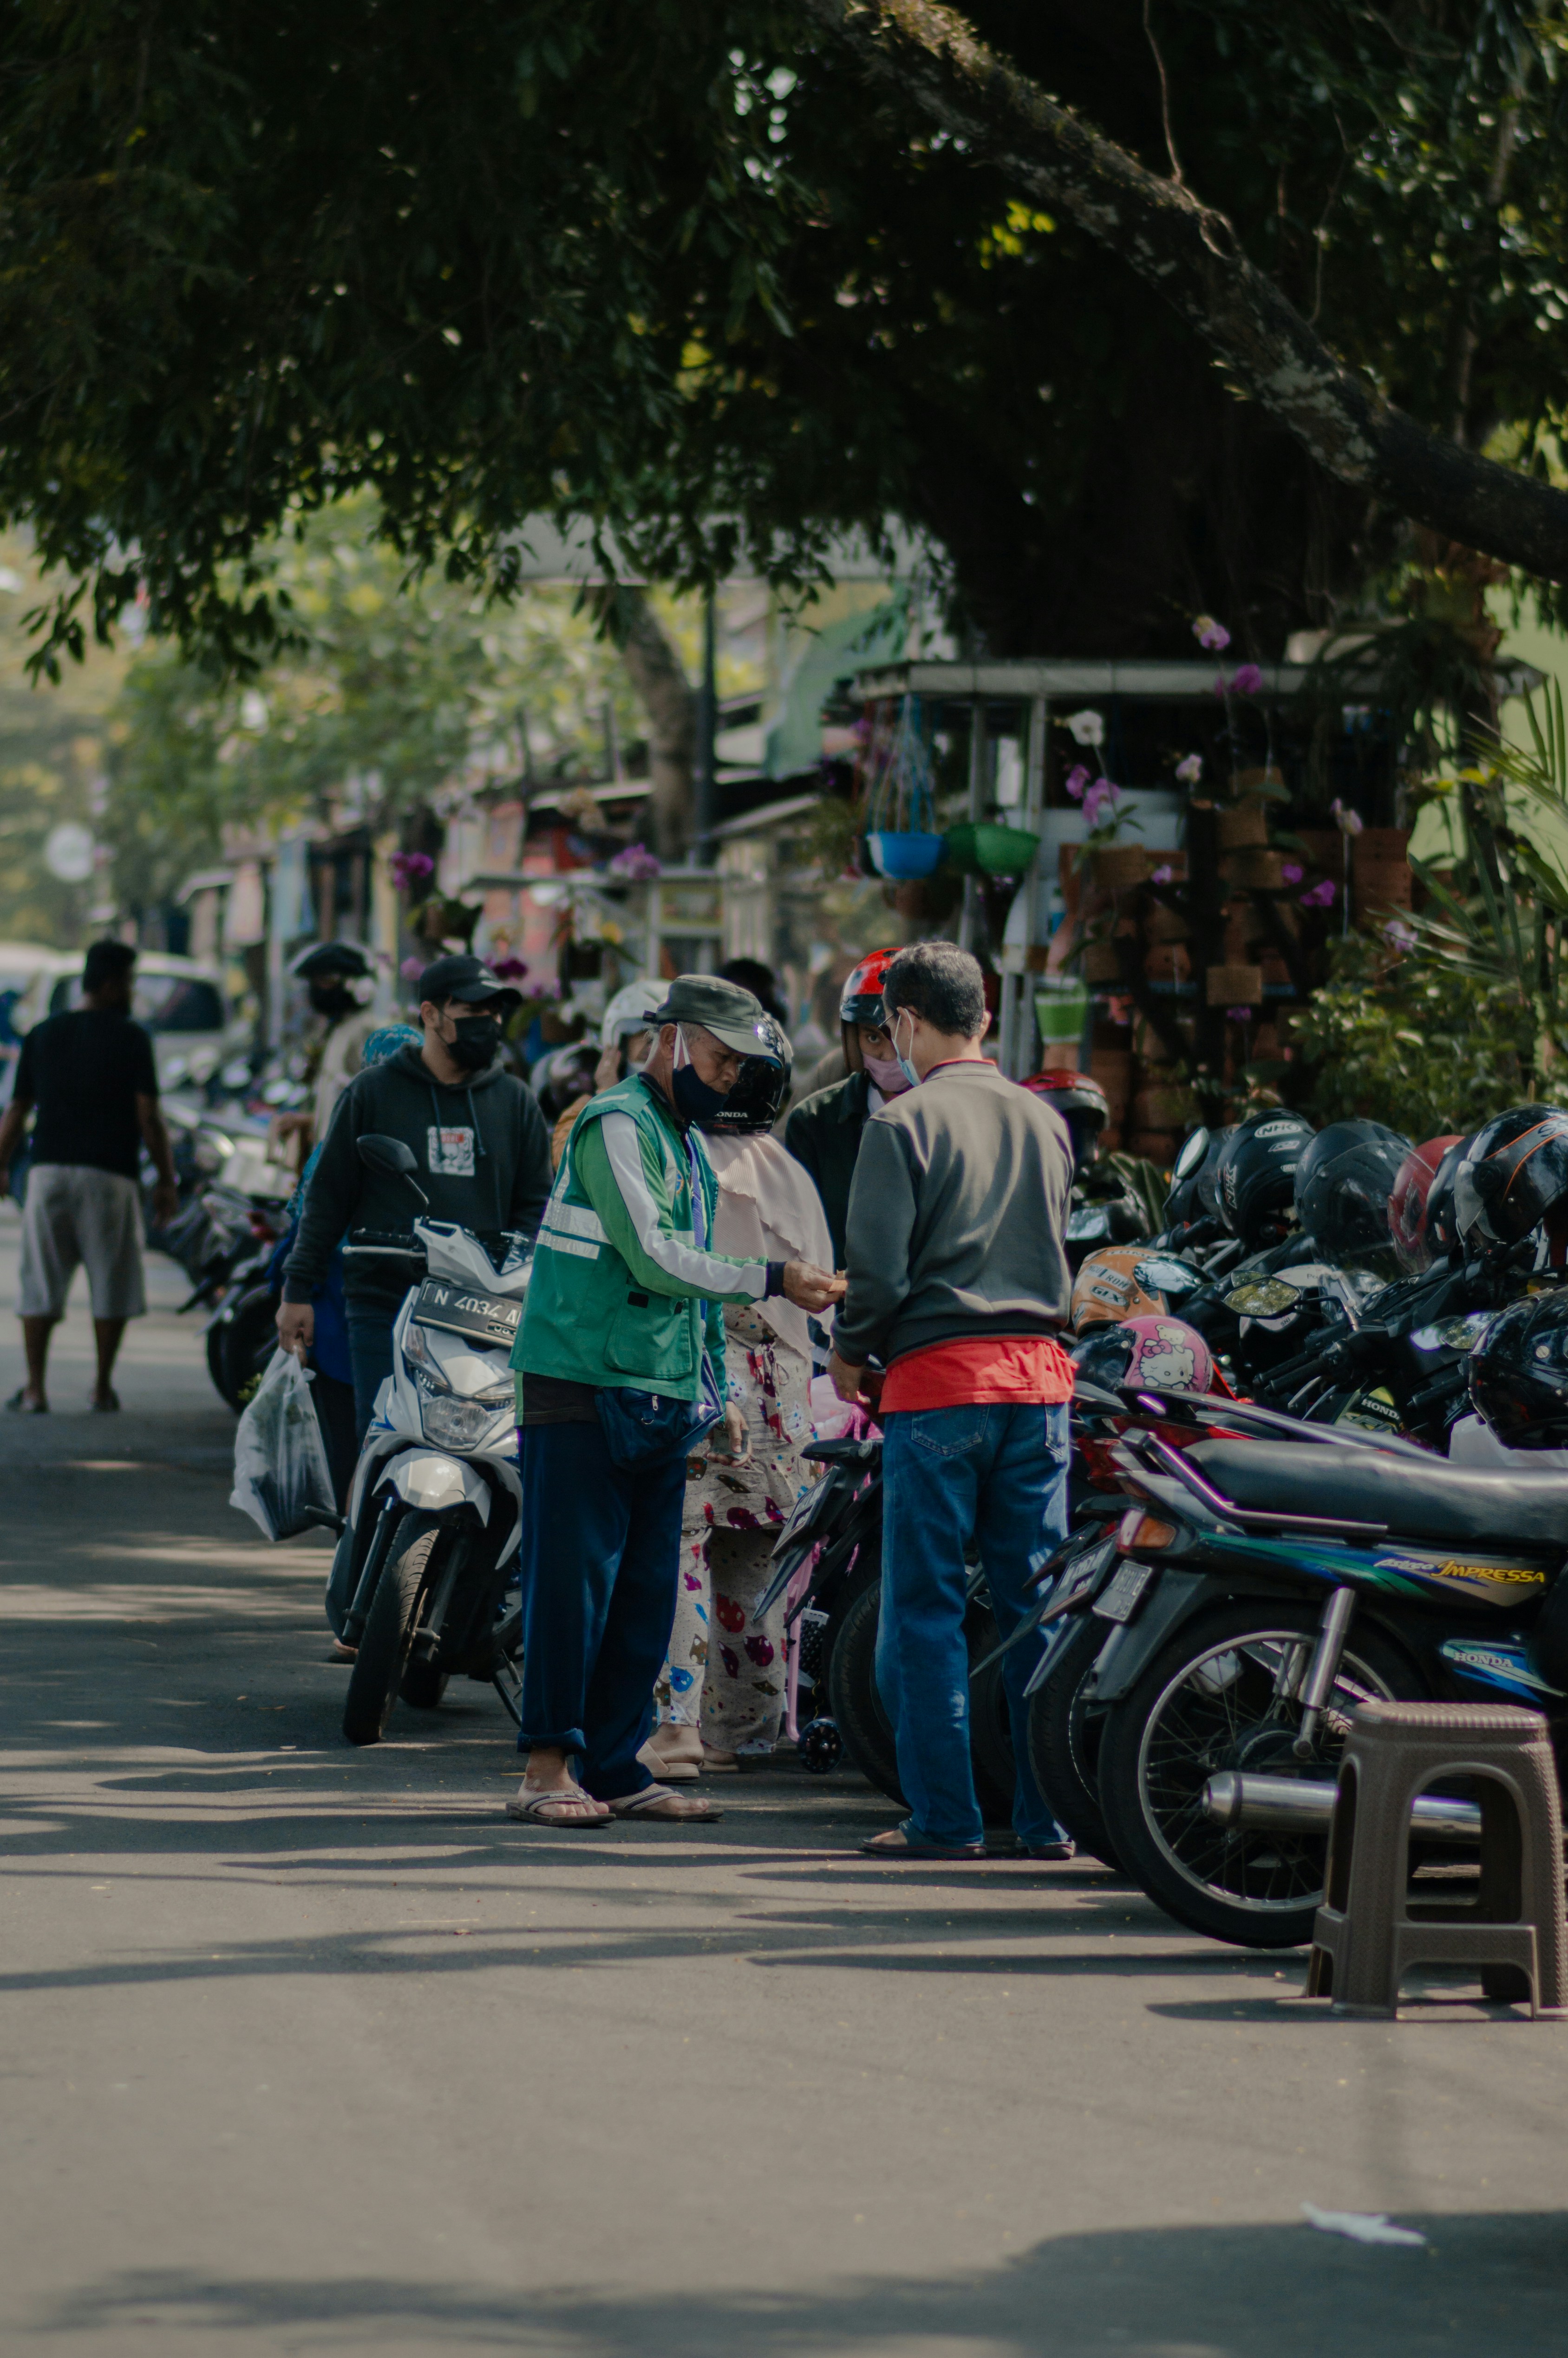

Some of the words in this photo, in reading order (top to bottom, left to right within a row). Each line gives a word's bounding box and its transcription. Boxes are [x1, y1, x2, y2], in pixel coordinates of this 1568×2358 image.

[1262, 1123, 1295, 1135] NHK
[1225, 1161, 1238, 1210] NHK
[434, 1289, 449, 1306] N
[454, 1296, 502, 1318] 4034
[1430, 1560, 1545, 1584] IMPRESSA
[1453, 1652, 1514, 1668] HONDA
